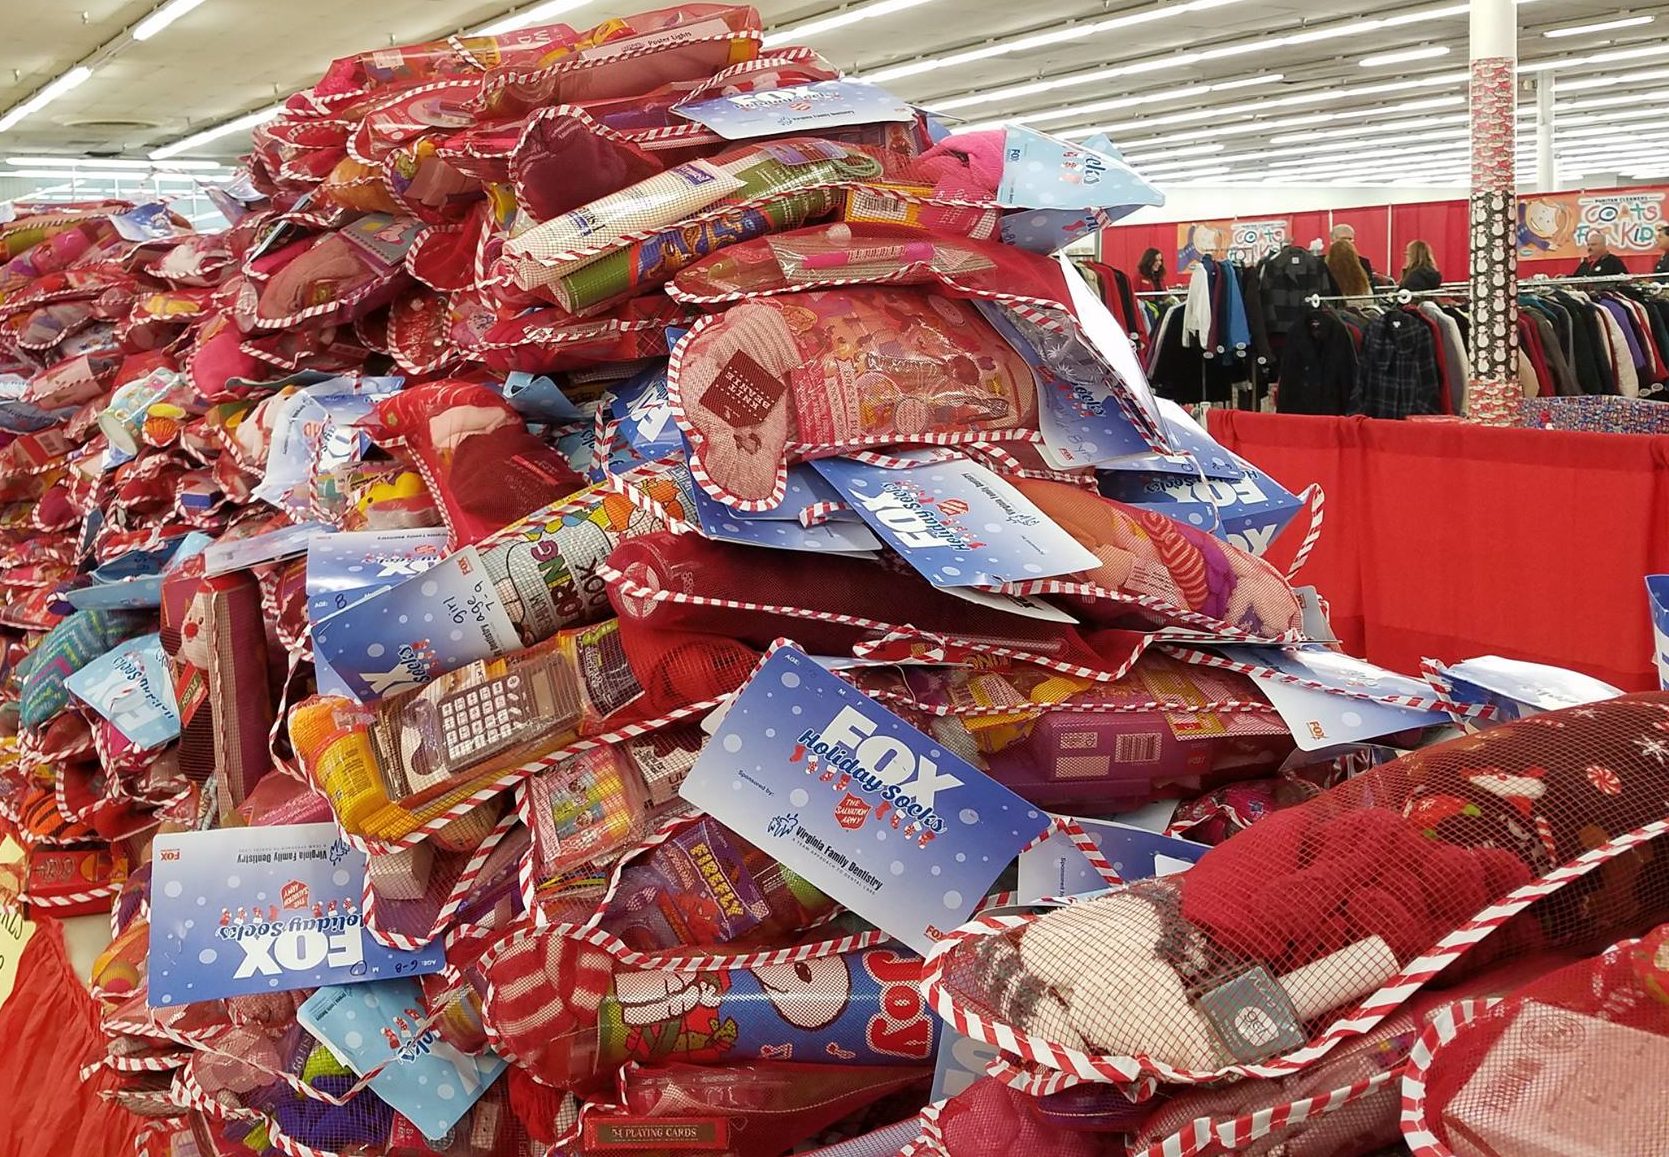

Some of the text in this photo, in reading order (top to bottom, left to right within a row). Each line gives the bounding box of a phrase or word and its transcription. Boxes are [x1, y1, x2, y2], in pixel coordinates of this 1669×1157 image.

[725, 370, 770, 410] BEANIE
[727, 384, 760, 411] KNIT
[847, 487, 954, 549] FOX
[531, 539, 582, 617] ORING
[820, 704, 966, 808] FOX
[737, 768, 765, 790] Sponsored
[797, 727, 948, 835] Holiday Socks
[834, 805, 869, 818] SALVATION
[844, 797, 861, 807] THE
[841, 814, 864, 826] ARMY
[160, 850, 180, 861] FOX
[236, 851, 272, 864] Dentistry
[273, 851, 297, 863] Family
[298, 849, 328, 861] Virginia
[796, 824, 884, 891] Virginia Family Dentistry
[690, 842, 744, 917] FIREFLY
[218, 913, 365, 941] Socks oliday
[233, 925, 363, 980] FOX
[625, 1127, 663, 1138] PLAYING
[665, 1127, 697, 1138] CARDS
